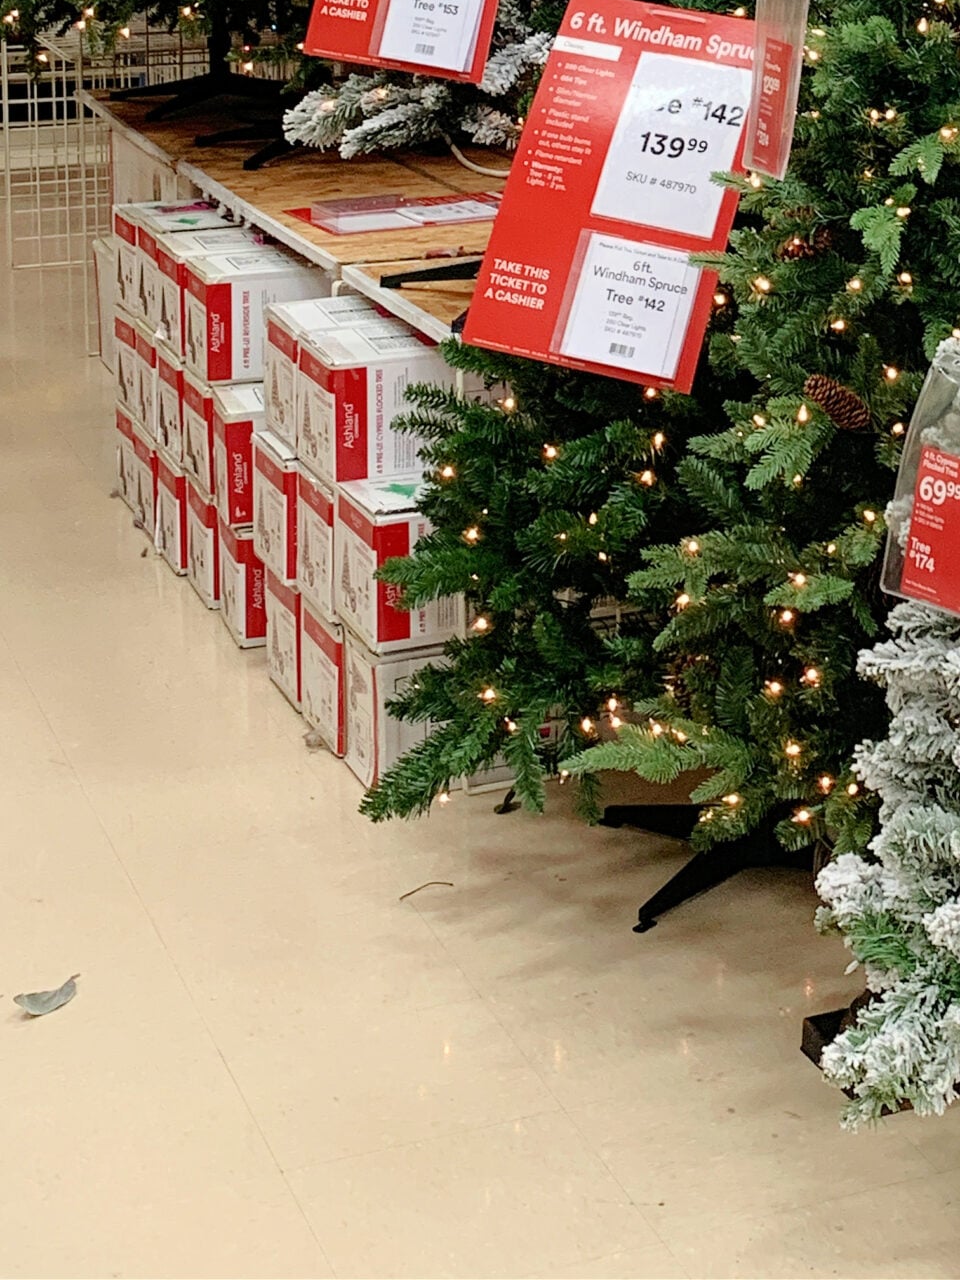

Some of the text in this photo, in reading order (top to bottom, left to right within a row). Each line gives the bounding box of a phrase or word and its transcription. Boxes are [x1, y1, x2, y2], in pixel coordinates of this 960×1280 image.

[320, 4, 368, 22] A CASHIER
[569, 11, 755, 60] 6 ft. Windham Spru
[692, 96, 745, 128] #142
[626, 170, 698, 195] SKU # 487970
[493, 258, 550, 281] TAKE THIS
[593, 265, 689, 295] Windham Spruce
[490, 272, 548, 295] TICKET TO
[484, 287, 545, 310] A CASHIER
[606, 288, 666, 313] Tree #142
[210, 312, 220, 353] Ashland
[375, 384, 383, 413] FLOCKED
[343, 402, 355, 449] Ashland
[232, 452, 243, 494] Ashland
[945, 465, 959, 478] Tree
[911, 536, 932, 555] Tree
[252, 569, 262, 609] Ashland
